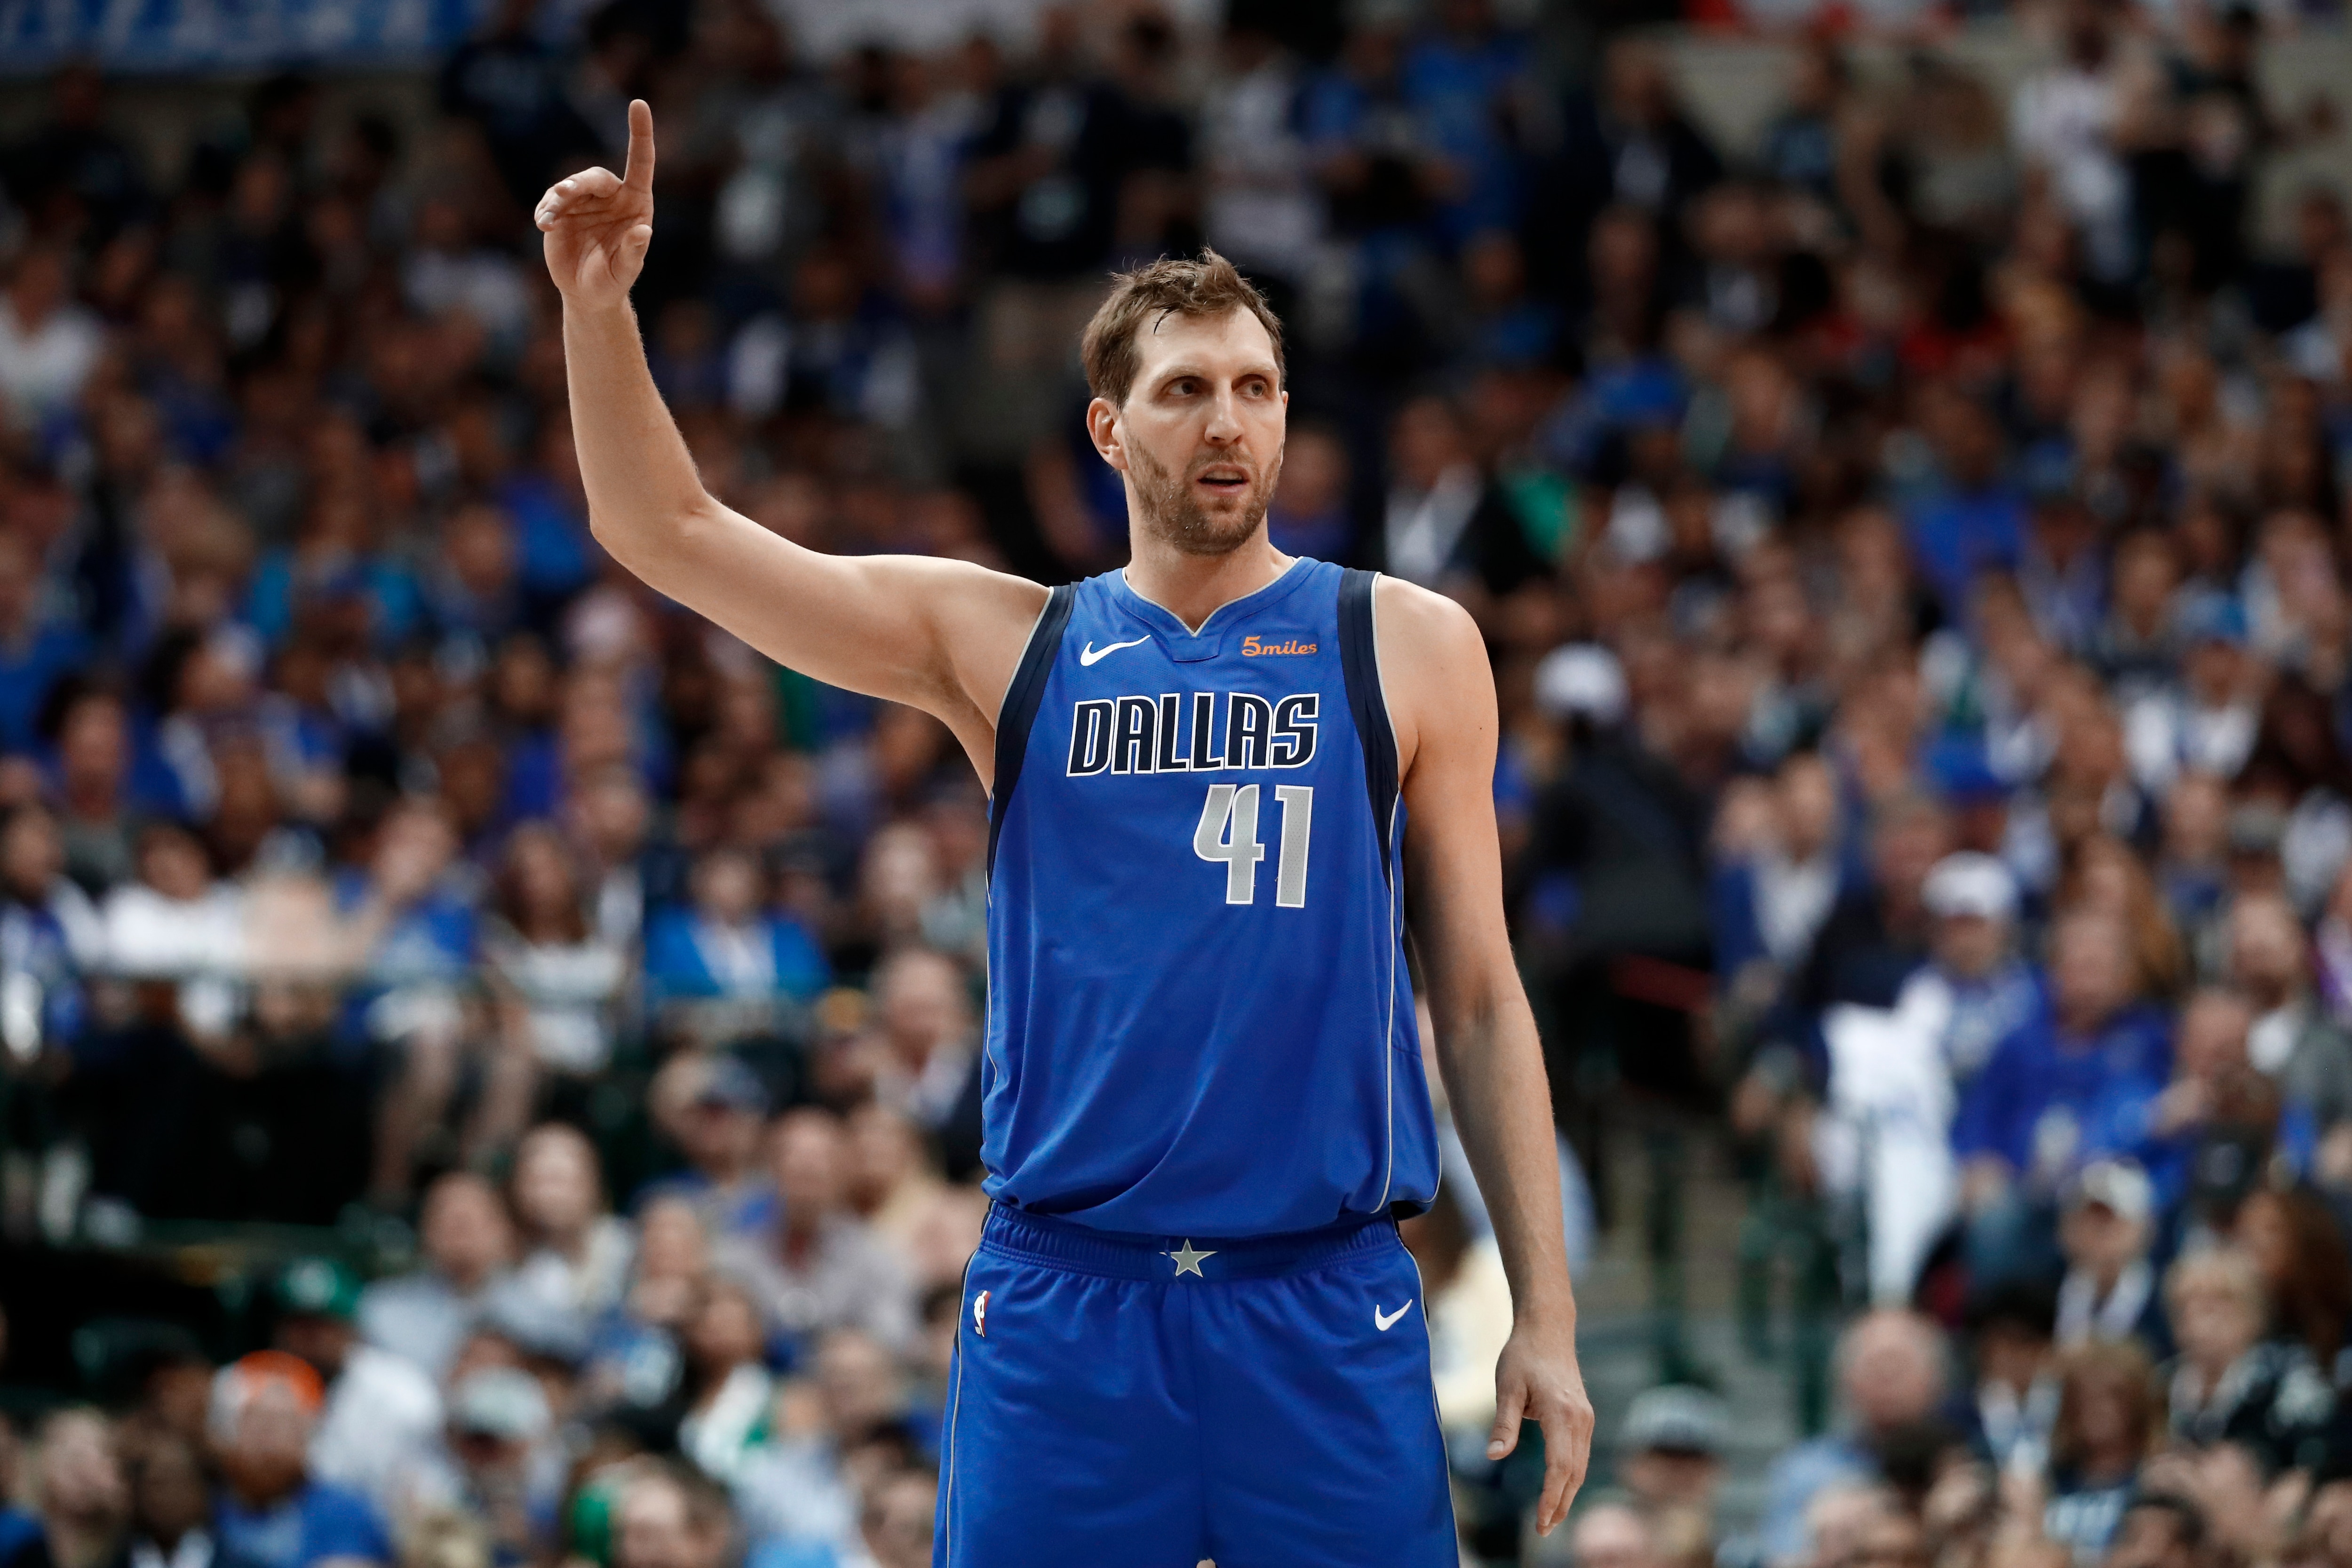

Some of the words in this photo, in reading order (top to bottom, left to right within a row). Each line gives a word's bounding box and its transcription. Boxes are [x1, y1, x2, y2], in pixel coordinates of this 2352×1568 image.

[1242, 636, 1317, 656] 5miles
[1066, 692, 1319, 777] DALLAS
[1193, 784, 1313, 908] 41
